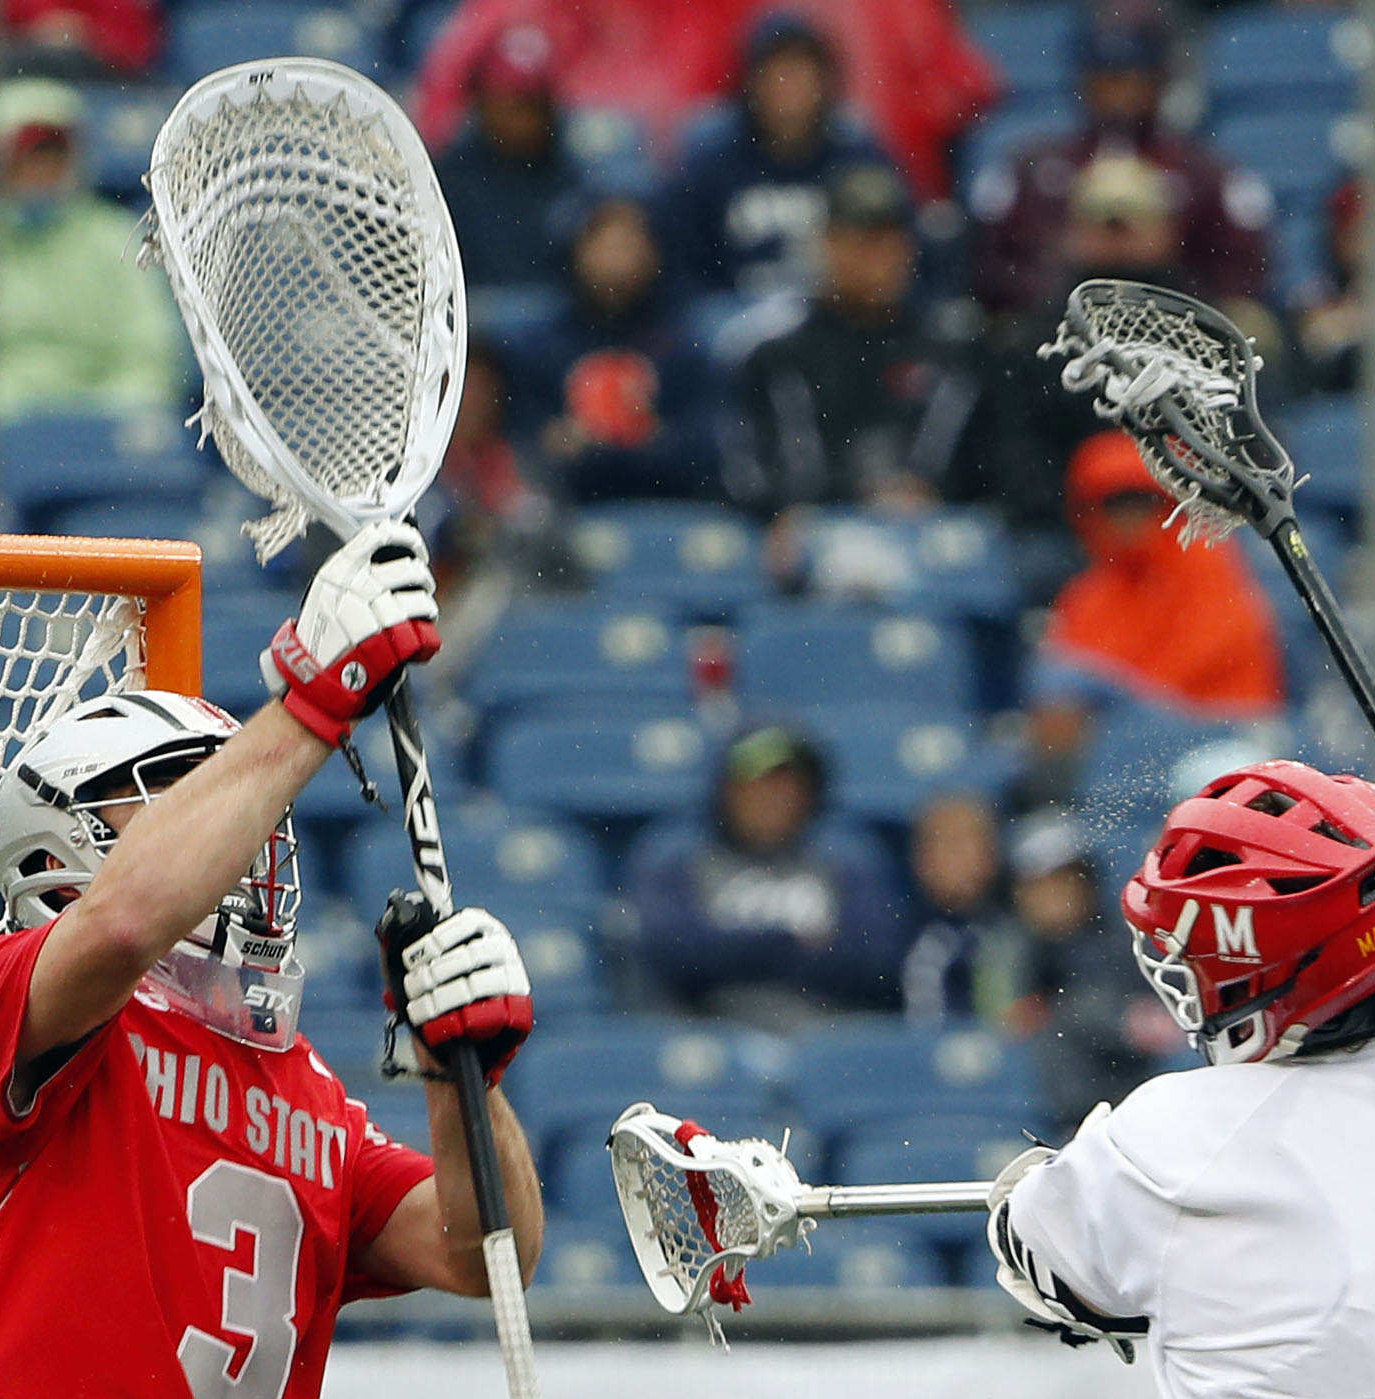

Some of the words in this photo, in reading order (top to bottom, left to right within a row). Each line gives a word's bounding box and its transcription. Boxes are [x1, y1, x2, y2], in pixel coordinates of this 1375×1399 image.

[222, 895, 247, 908] STX
[1210, 903, 1261, 957] M
[243, 984, 294, 1015] STX
